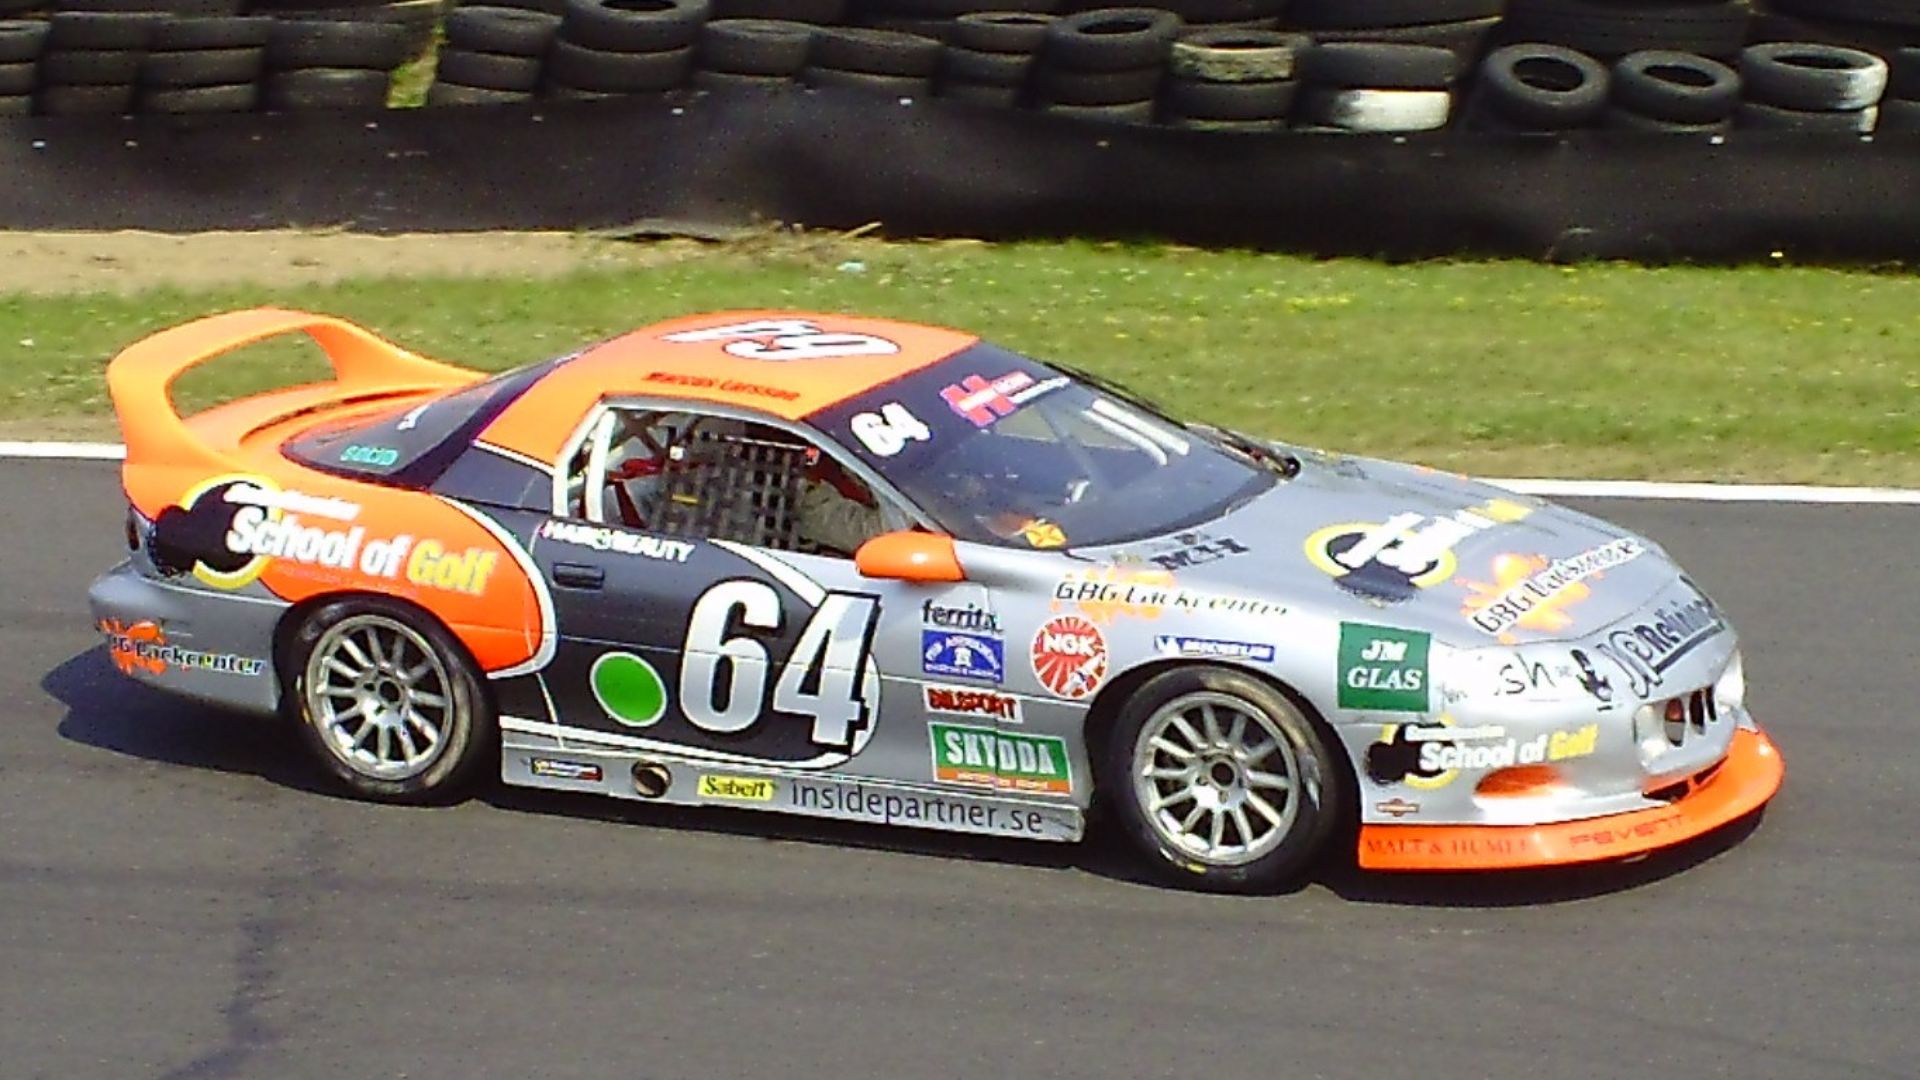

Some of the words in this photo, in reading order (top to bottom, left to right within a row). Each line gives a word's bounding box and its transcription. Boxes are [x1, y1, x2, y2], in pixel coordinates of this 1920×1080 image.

[850, 402, 932, 457] 64
[225, 505, 366, 569] School
[360, 535, 412, 579] of
[405, 539, 498, 597] Golf
[922, 598, 1004, 633] ferrita
[680, 576, 882, 750] 64
[1042, 632, 1097, 657] NGK
[1361, 639, 1408, 661] JM
[1346, 665, 1424, 690] GLAS
[943, 729, 1057, 774] SKYDDA
[1419, 738, 1516, 771] School
[1517, 732, 1549, 764] of
[791, 779, 1044, 834] insidepartner.se
